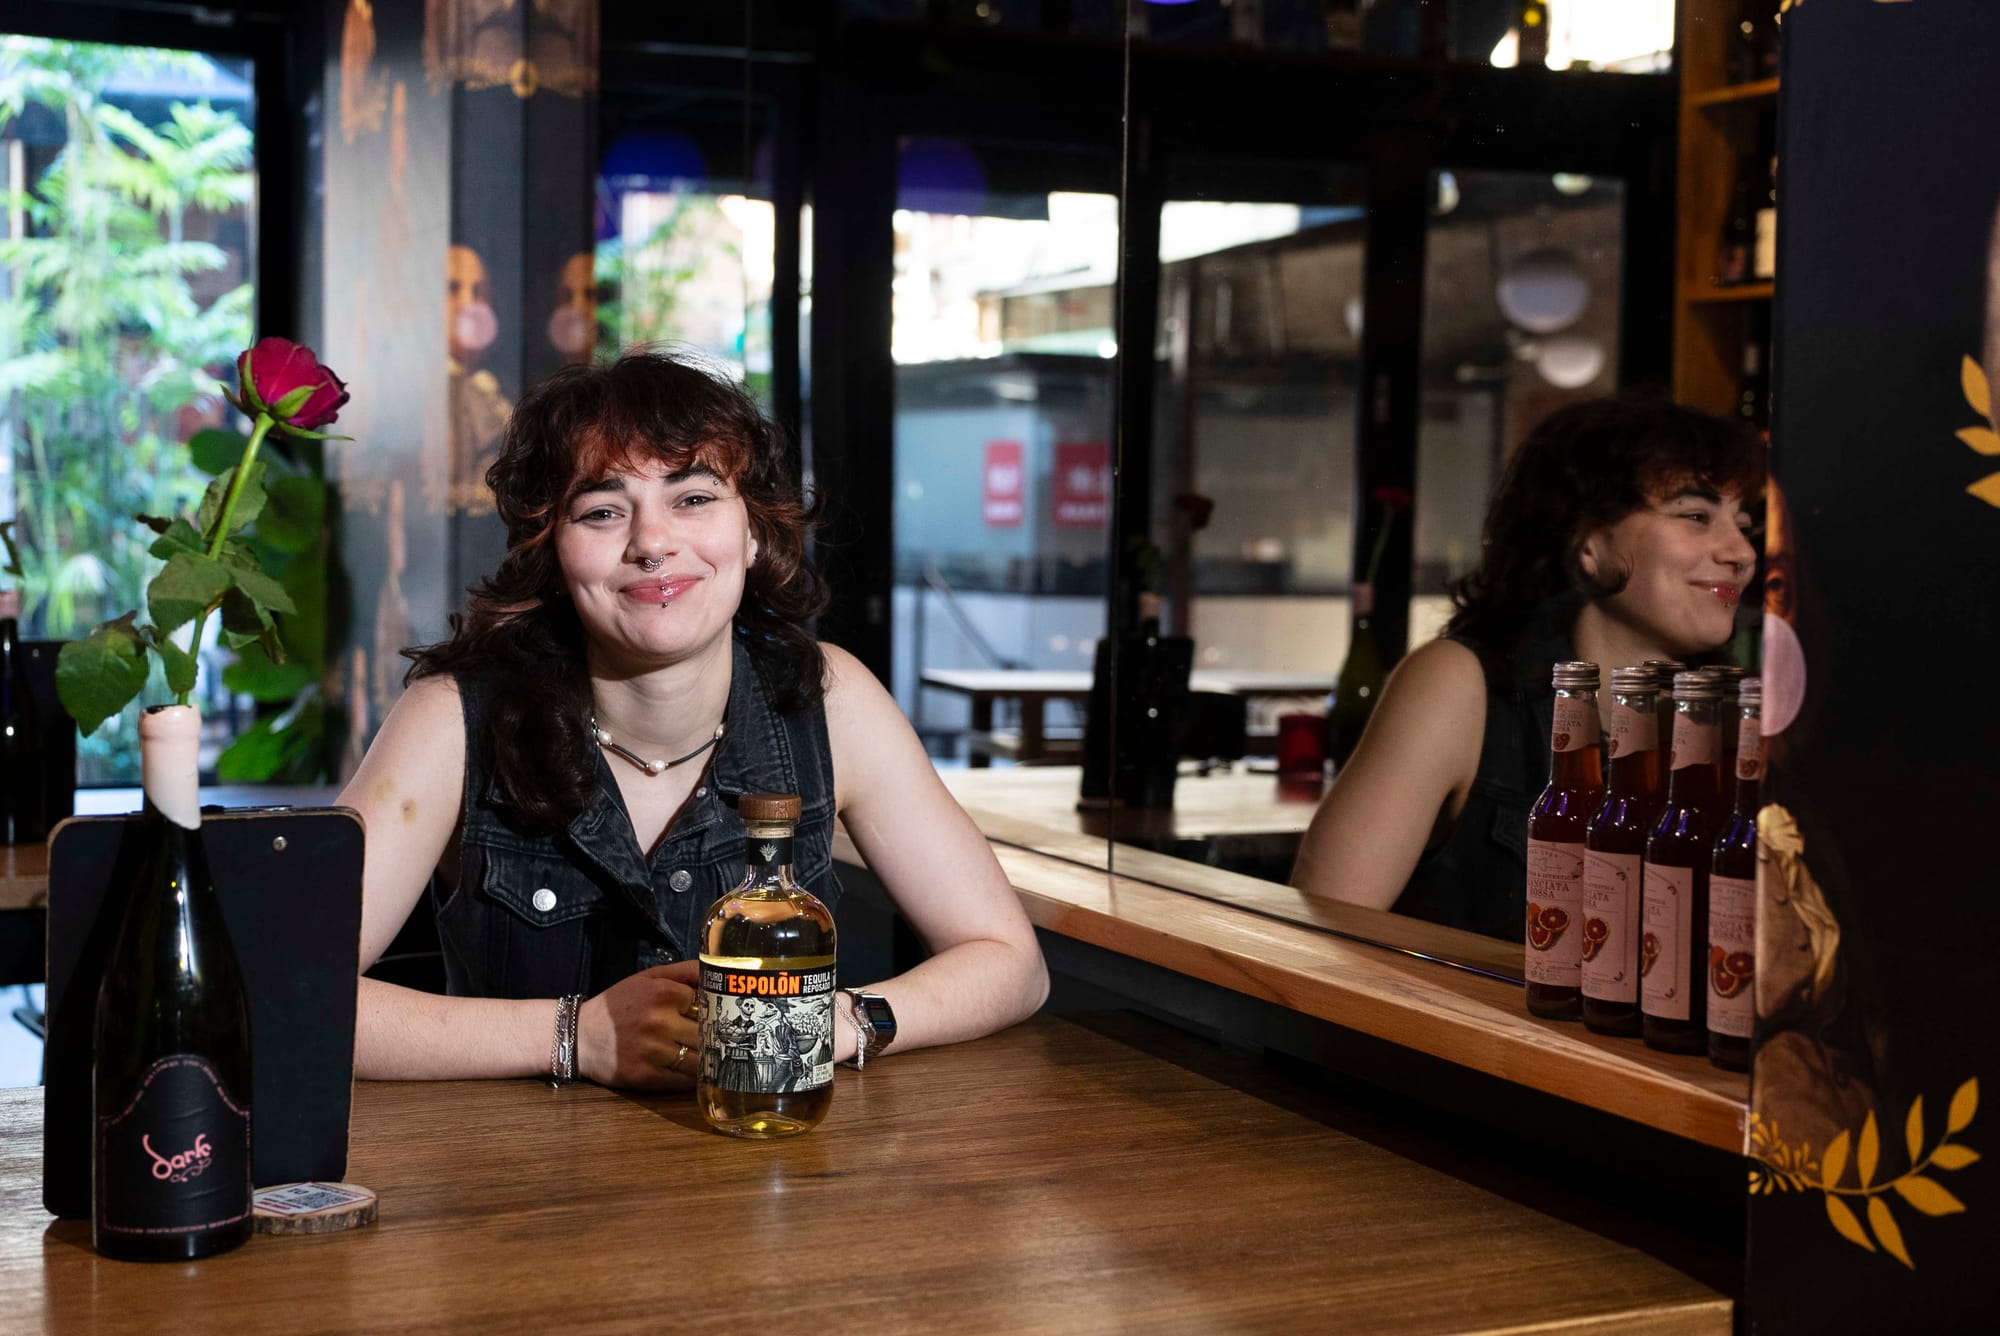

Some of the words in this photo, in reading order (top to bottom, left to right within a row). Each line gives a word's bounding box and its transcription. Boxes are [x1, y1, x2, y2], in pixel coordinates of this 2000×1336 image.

[802, 971, 831, 985] TEQUILA
[802, 981, 831, 994] REPOSADO
[142, 1133, 212, 1179] dark
